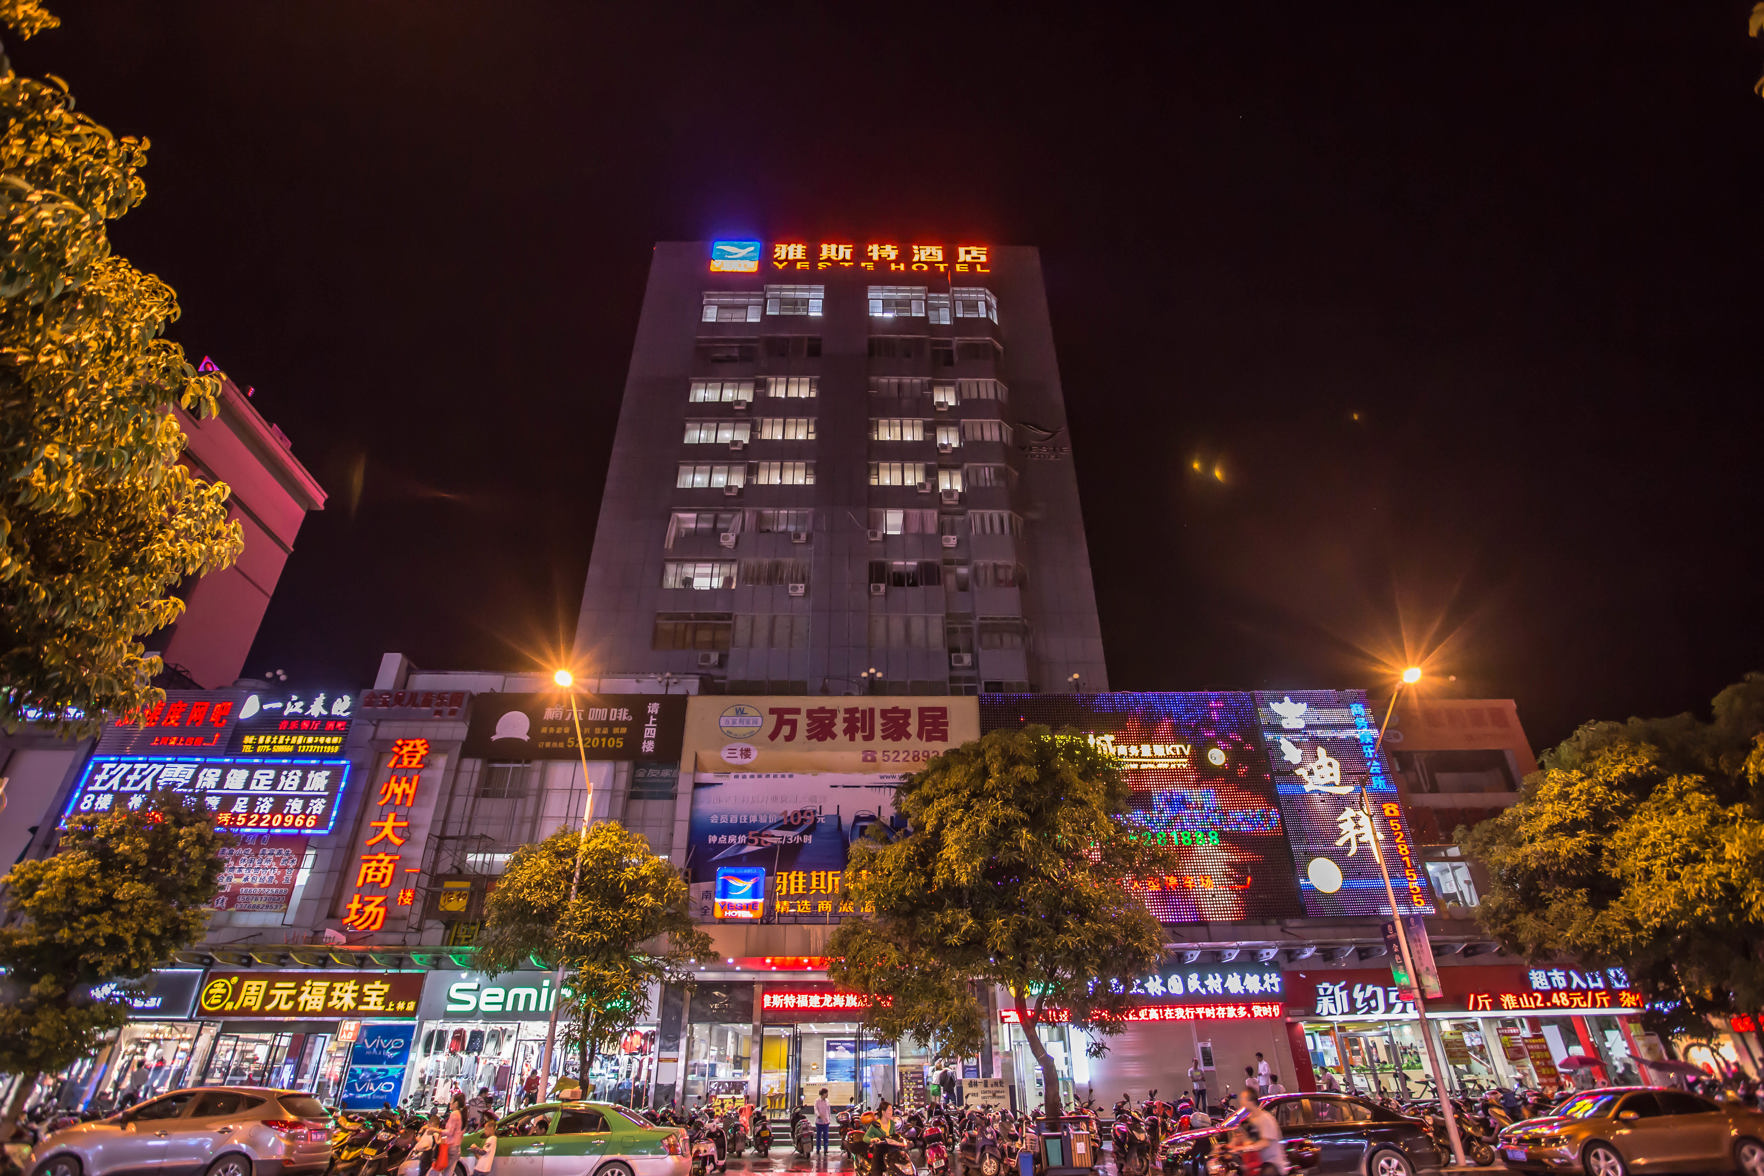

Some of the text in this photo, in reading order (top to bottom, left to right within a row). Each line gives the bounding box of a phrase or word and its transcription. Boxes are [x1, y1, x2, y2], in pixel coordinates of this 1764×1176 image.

[773, 243, 988, 262] 雅斯特酒店
[890, 262, 991, 273] HOTEL
[641, 702, 661, 753] 请上四楼
[768, 706, 949, 742] 万家利家居
[726, 748, 752, 759] 三楼
[282, 798, 327, 815] 泡浴
[342, 738, 430, 932] 澄州大商场
[1388, 818, 1426, 907] 5281555
[718, 902, 760, 911] YESTE
[1528, 968, 1605, 990] 超市入口
[233, 979, 391, 1012] 周元福珠宝
[364, 1036, 405, 1049] vivo
